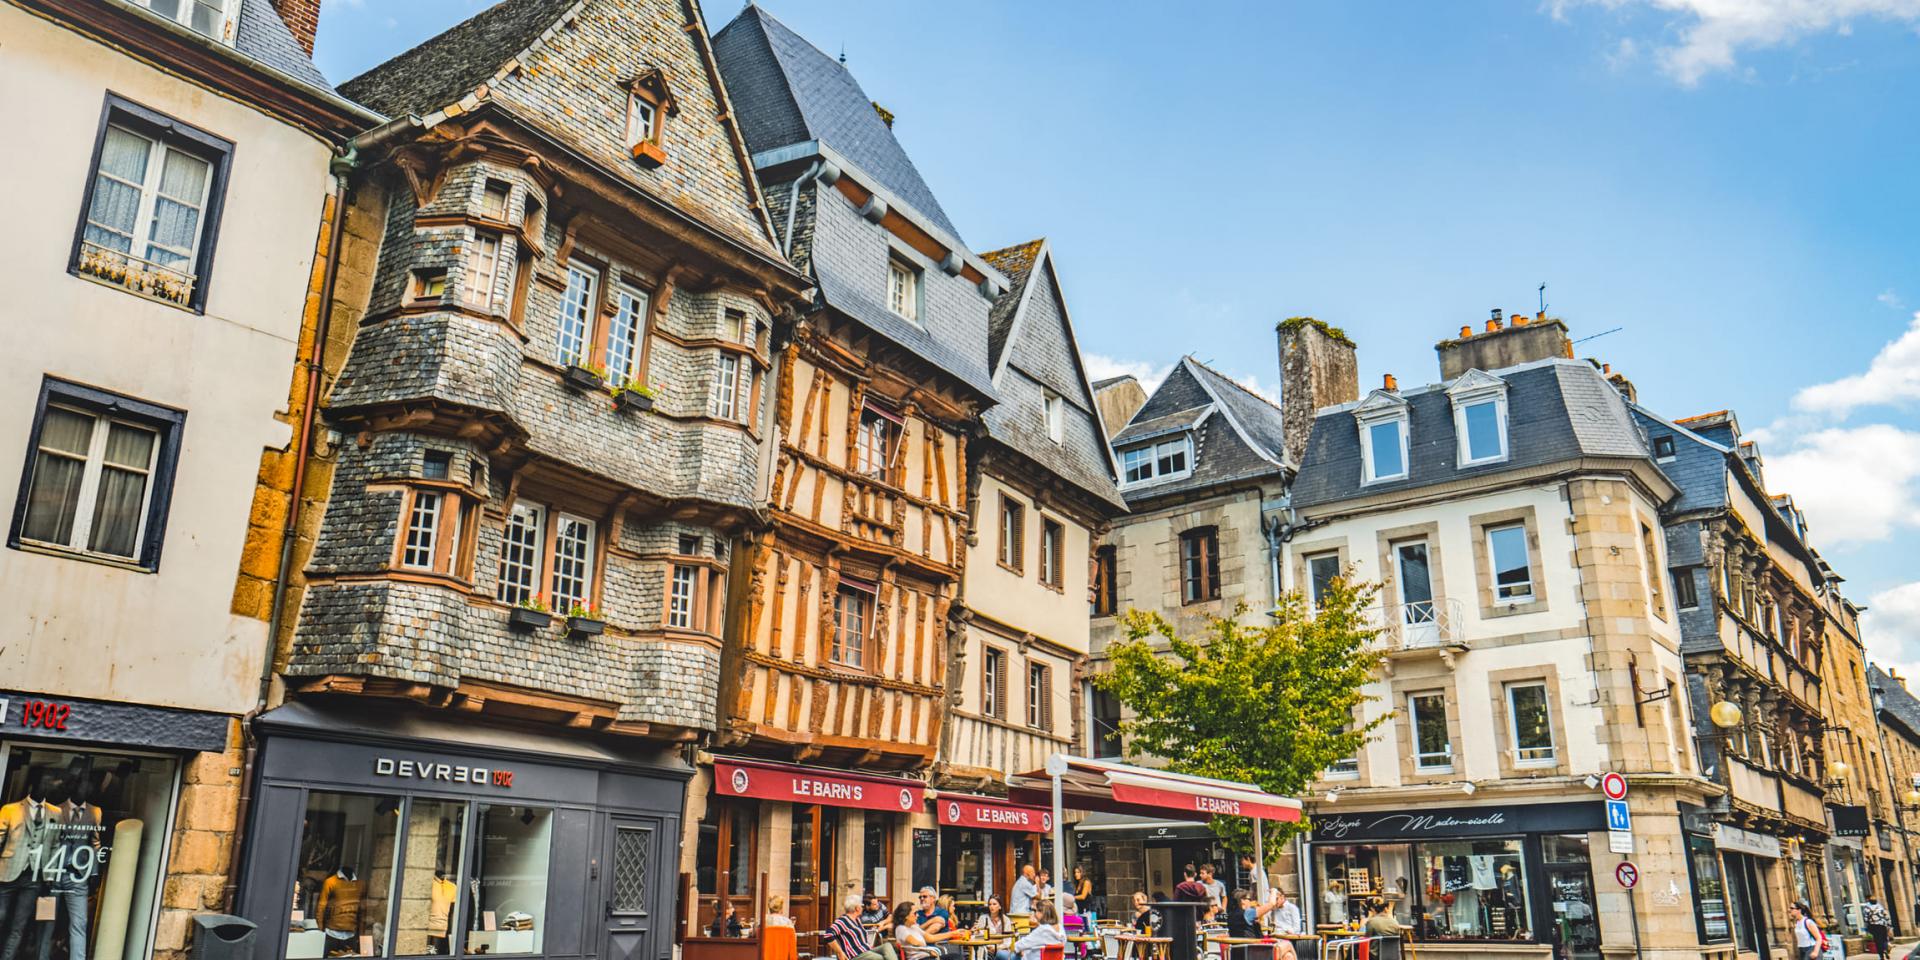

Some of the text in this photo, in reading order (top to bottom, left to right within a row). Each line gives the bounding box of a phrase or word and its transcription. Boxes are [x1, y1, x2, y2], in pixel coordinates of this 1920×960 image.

[22, 700, 71, 729] 1902
[376, 757, 514, 787] DEVRED 1902
[792, 779, 863, 800] LE BARN'S
[1195, 796, 1209, 811] LE
[976, 808, 991, 822] LE
[991, 810, 1029, 825] BARN'S
